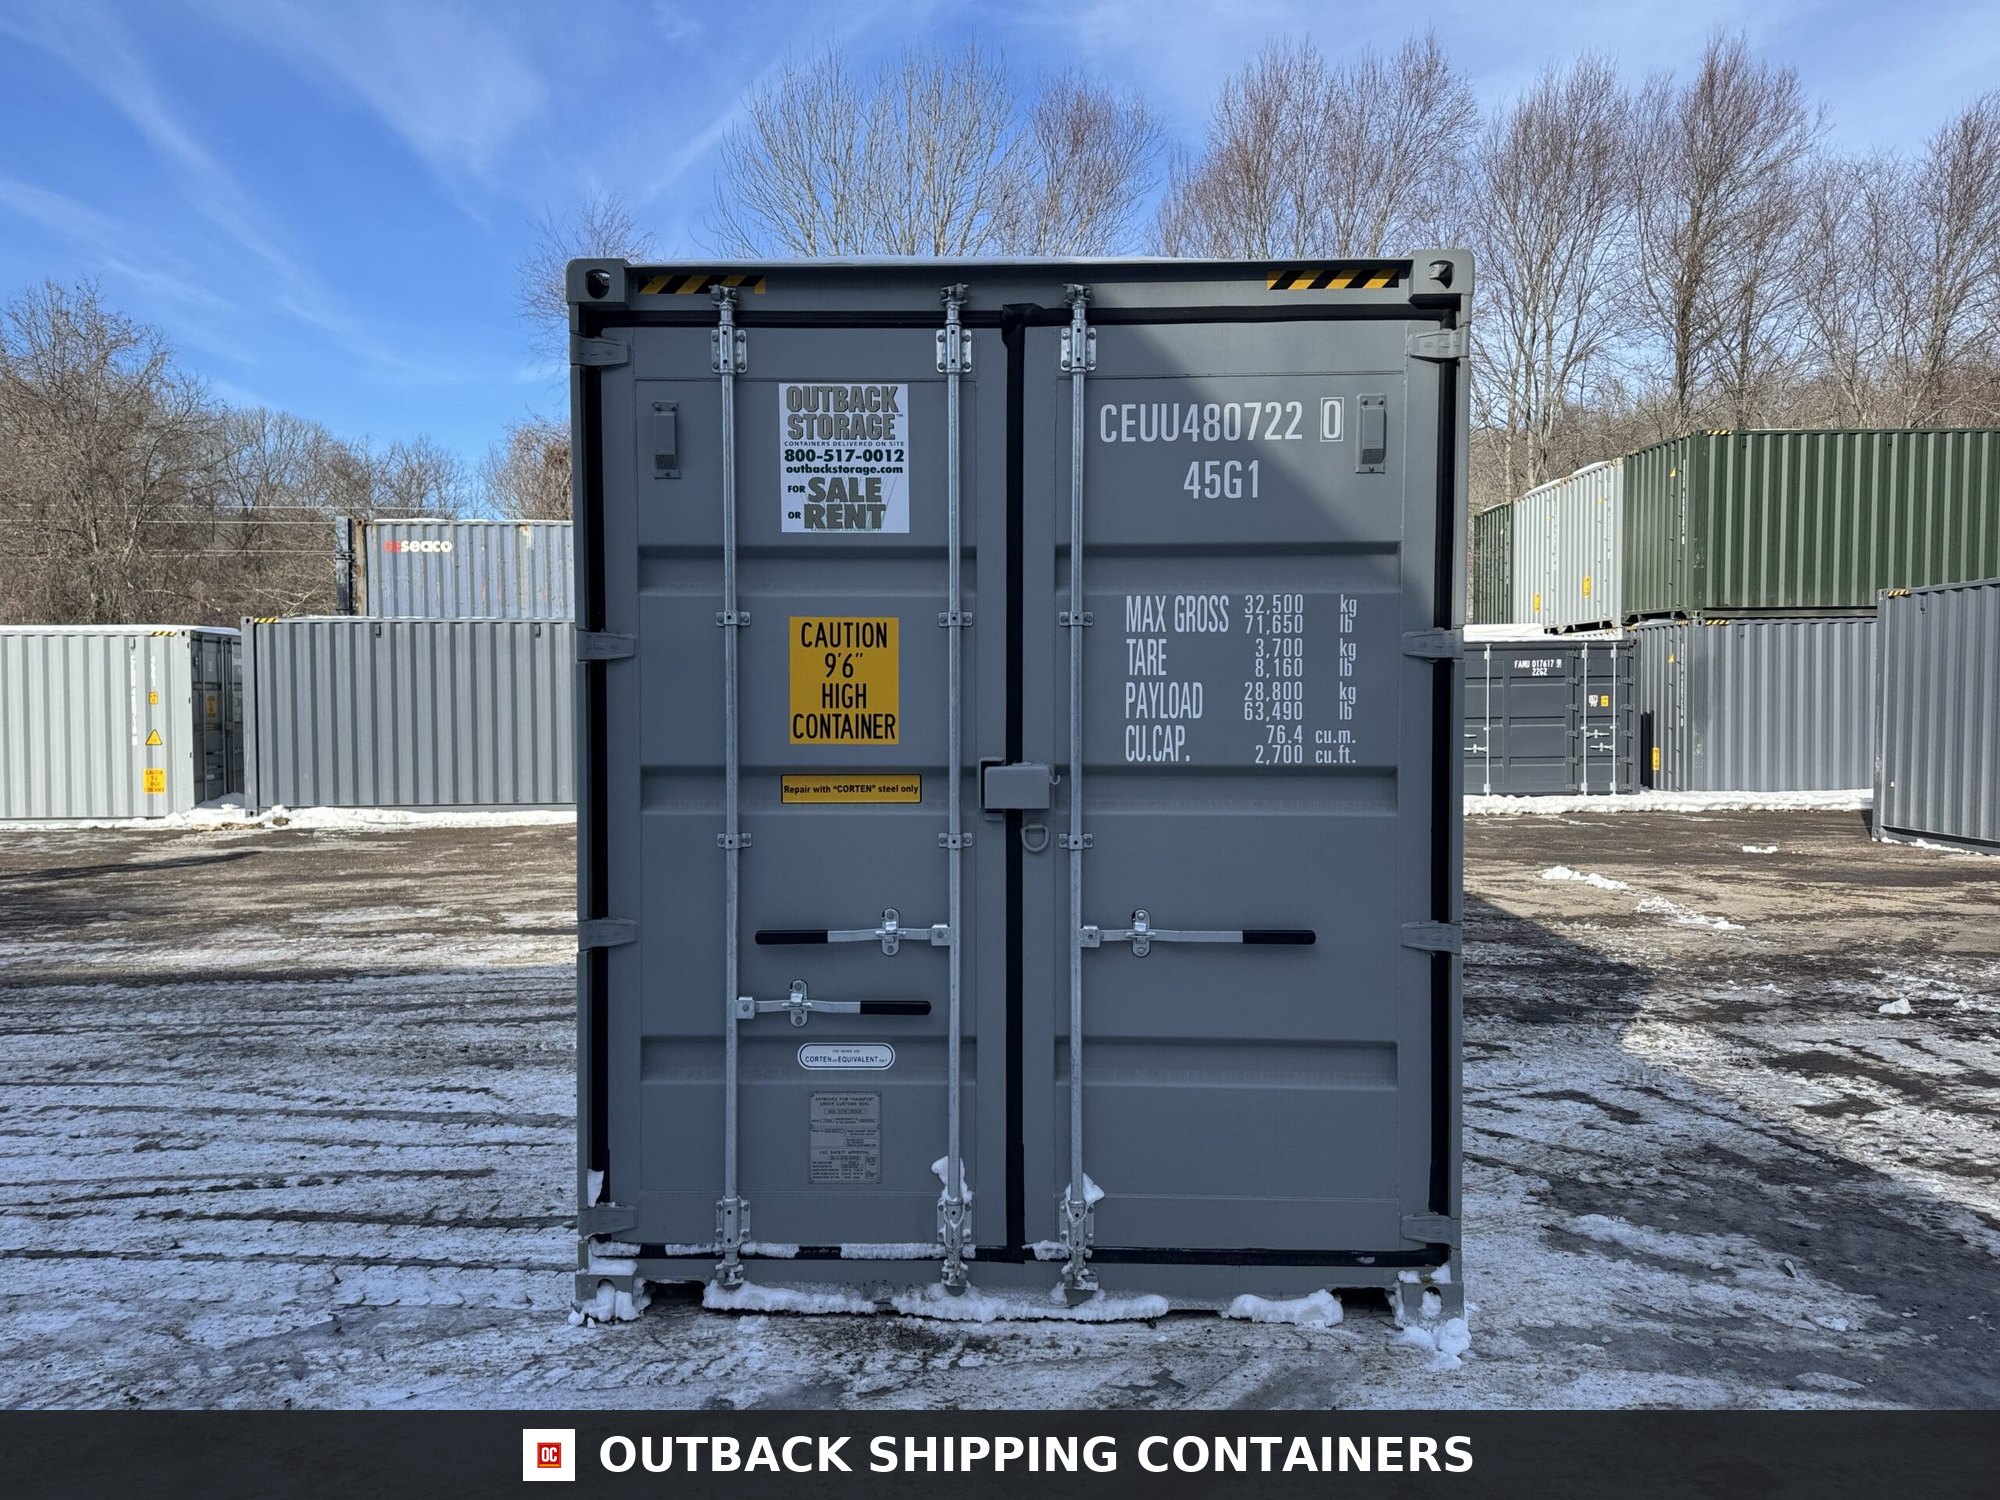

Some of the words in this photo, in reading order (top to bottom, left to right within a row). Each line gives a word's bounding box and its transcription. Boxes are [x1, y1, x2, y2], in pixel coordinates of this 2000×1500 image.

[786, 386, 899, 412] OUTBACK
[787, 414, 896, 440] STORAGE
[1100, 401, 1303, 443] CEUU480722
[1322, 400, 1342, 440] 0
[784, 449, 904, 462] 800-517-0012
[786, 464, 903, 475] outbackstorage.com
[1184, 460, 1259, 499] 45G1
[808, 477, 882, 503] SALE
[804, 504, 886, 529] RENT
[400, 540, 453, 553] seaco
[1126, 595, 1166, 633] MAX
[1174, 595, 1229, 633] GROSS
[1245, 594, 1303, 615] 32,500
[1340, 594, 1357, 617] kg
[1244, 614, 1303, 635] 71,650
[1340, 614, 1353, 633] lb
[801, 622, 887, 648] CAUTION
[1126, 639, 1167, 676] TARE
[1255, 638, 1303, 659] 3,700
[1339, 638, 1356, 661] kg
[1255, 658, 1303, 679] 8,160
[1339, 658, 1352, 677] lb
[822, 683, 866, 709] HIGH
[1125, 682, 1203, 719] PAYLOAD
[1244, 681, 1303, 702] 28,800
[1339, 681, 1356, 704] kg
[1244, 702, 1303, 722] 63,490
[1339, 702, 1352, 720] lb
[793, 714, 896, 739] CONTAINER
[1125, 725, 1190, 762] CU.CAP.
[1266, 725, 1303, 744] 76.4
[1315, 729, 1356, 744] cu.m.
[1255, 745, 1303, 765] 2,700
[1315, 745, 1356, 764] cu.ft.
[784, 785, 811, 795] Repair
[813, 785, 831, 793] with
[878, 785, 898, 793] steel
[901, 785, 918, 795] only
